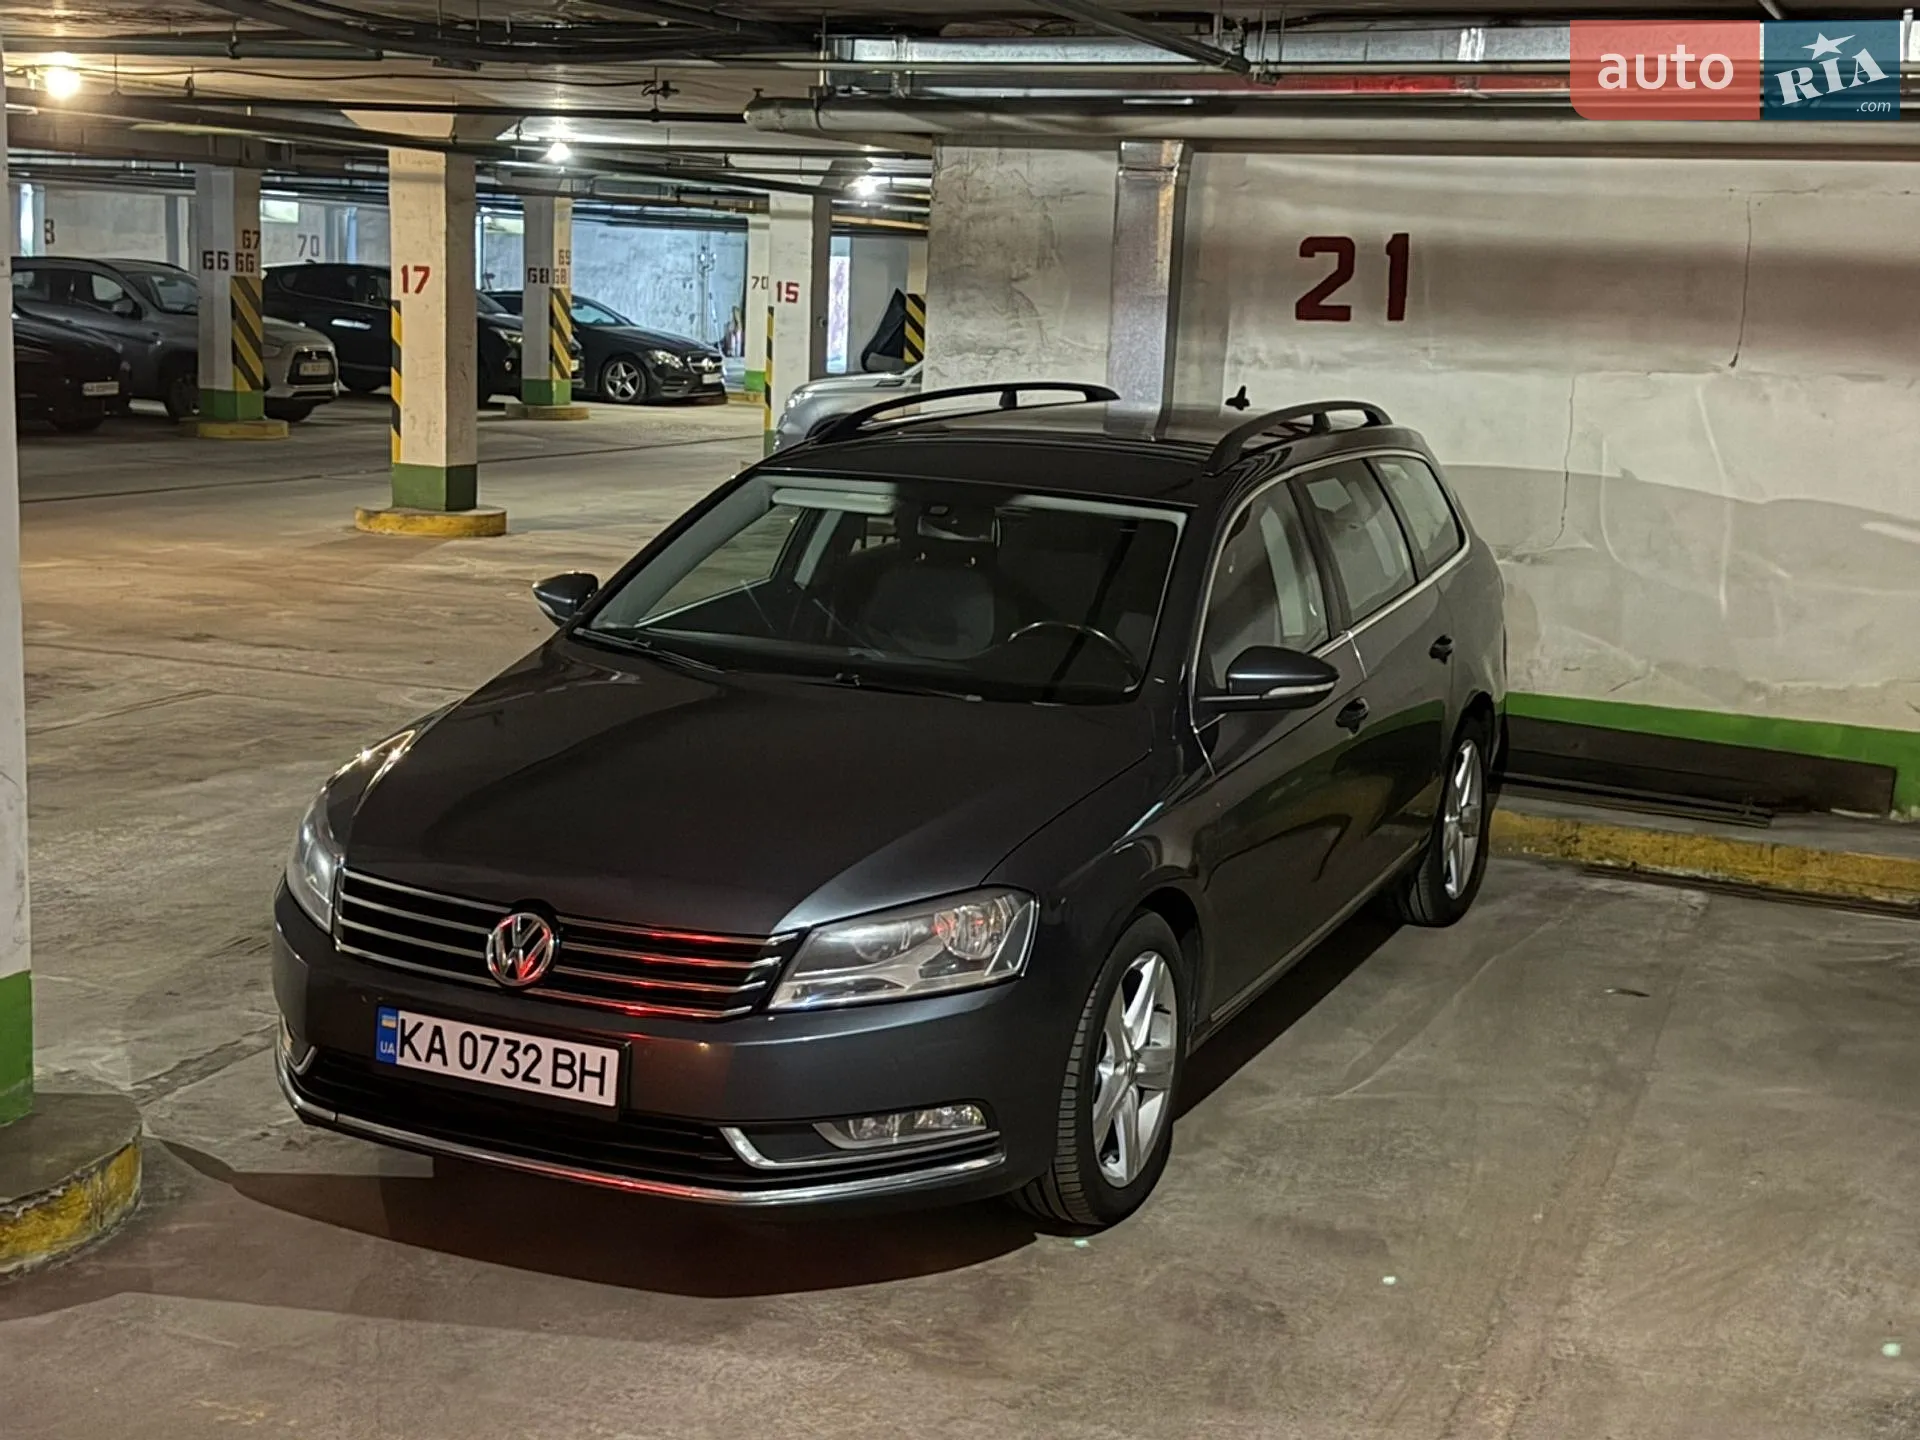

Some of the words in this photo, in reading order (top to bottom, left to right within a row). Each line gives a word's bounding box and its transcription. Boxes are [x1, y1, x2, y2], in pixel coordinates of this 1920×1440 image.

[297, 234, 320, 258] 70
[202, 249, 229, 271] 66
[401, 264, 431, 294] 17
[751, 275, 769, 290] 70
[1295, 232, 1410, 322] 21
[776, 280, 800, 304] 15
[380, 1040, 396, 1056] UA
[399, 1018, 448, 1067] KA
[458, 1031, 543, 1085] 0732
[551, 1047, 607, 1097] BH
